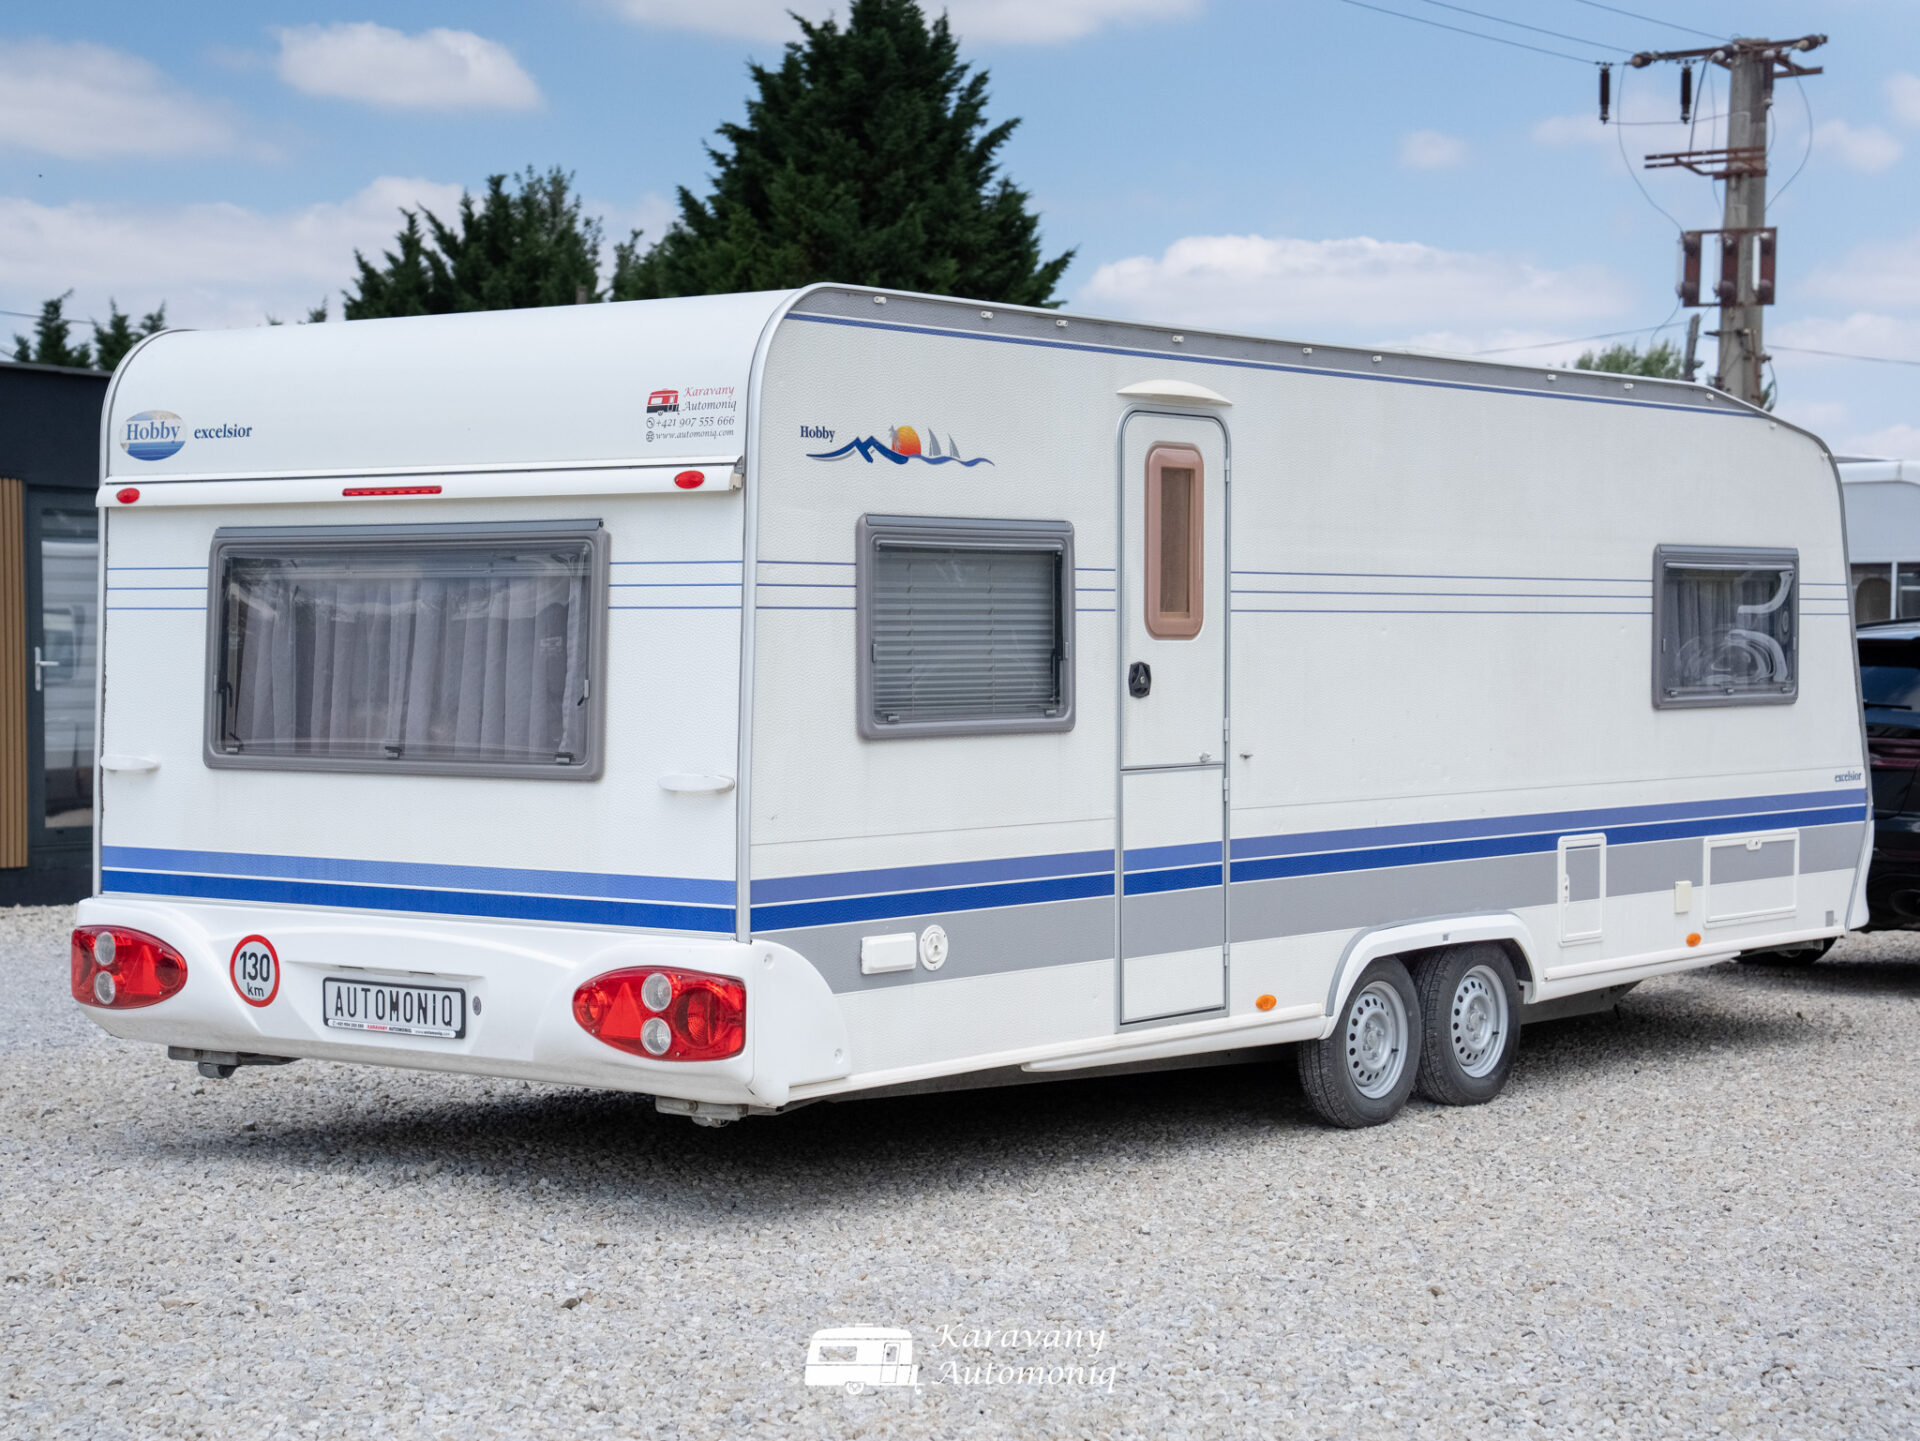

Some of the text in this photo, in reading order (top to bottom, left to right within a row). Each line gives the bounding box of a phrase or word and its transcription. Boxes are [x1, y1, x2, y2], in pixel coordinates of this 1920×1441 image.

[684, 386, 735, 398] Karavany
[682, 400, 737, 412] Automoniq
[679, 417, 697, 427] 907
[699, 416, 714, 427] 555
[717, 415, 735, 426] 666
[126, 420, 180, 443] Hobby
[194, 423, 253, 439] excelsior
[800, 425, 835, 443] Hobby
[240, 951, 270, 982] 130
[247, 982, 264, 997] km
[334, 985, 453, 1027] AUTOMONIQ
